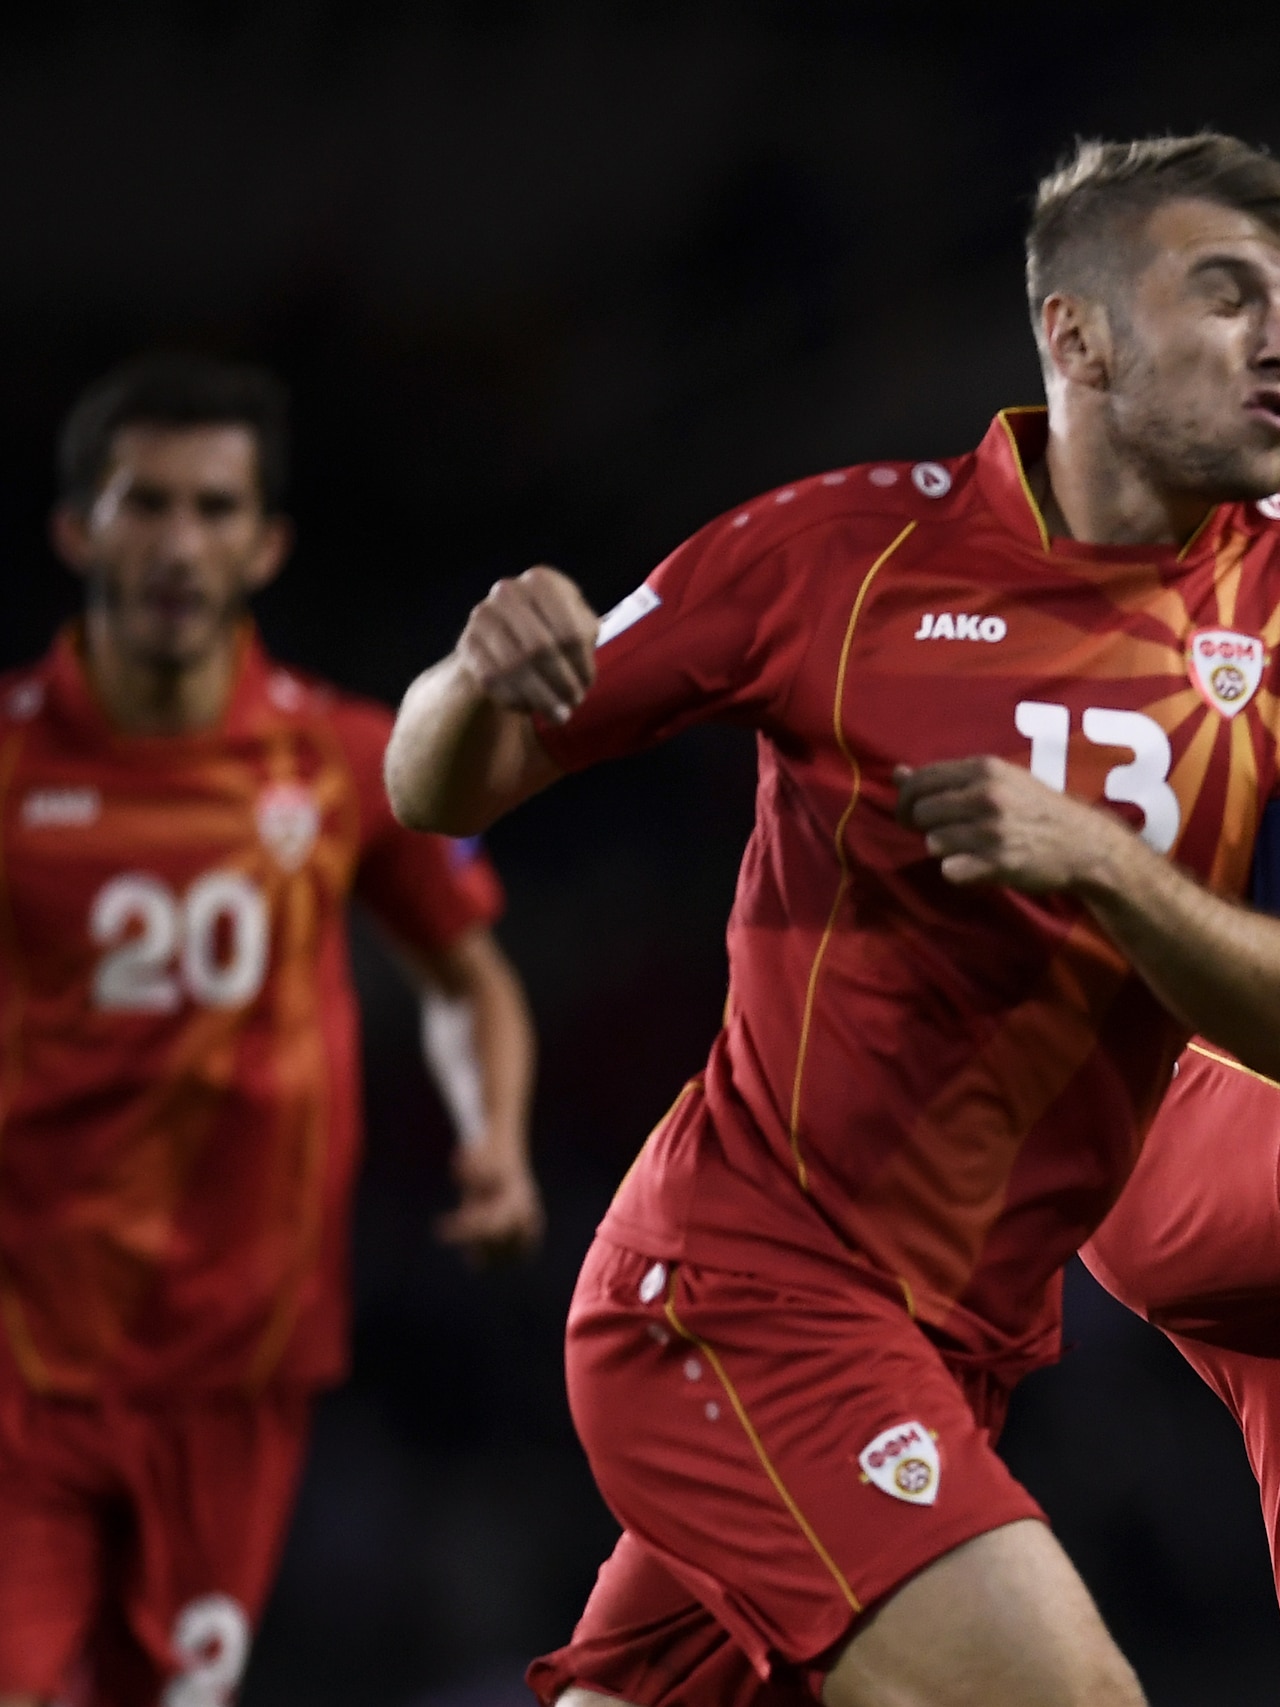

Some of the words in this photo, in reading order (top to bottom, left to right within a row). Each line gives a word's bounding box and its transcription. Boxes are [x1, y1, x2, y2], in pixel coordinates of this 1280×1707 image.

[915, 613, 1007, 643] JAKO
[1014, 700, 1181, 854] 13
[91, 868, 270, 1013] 20
